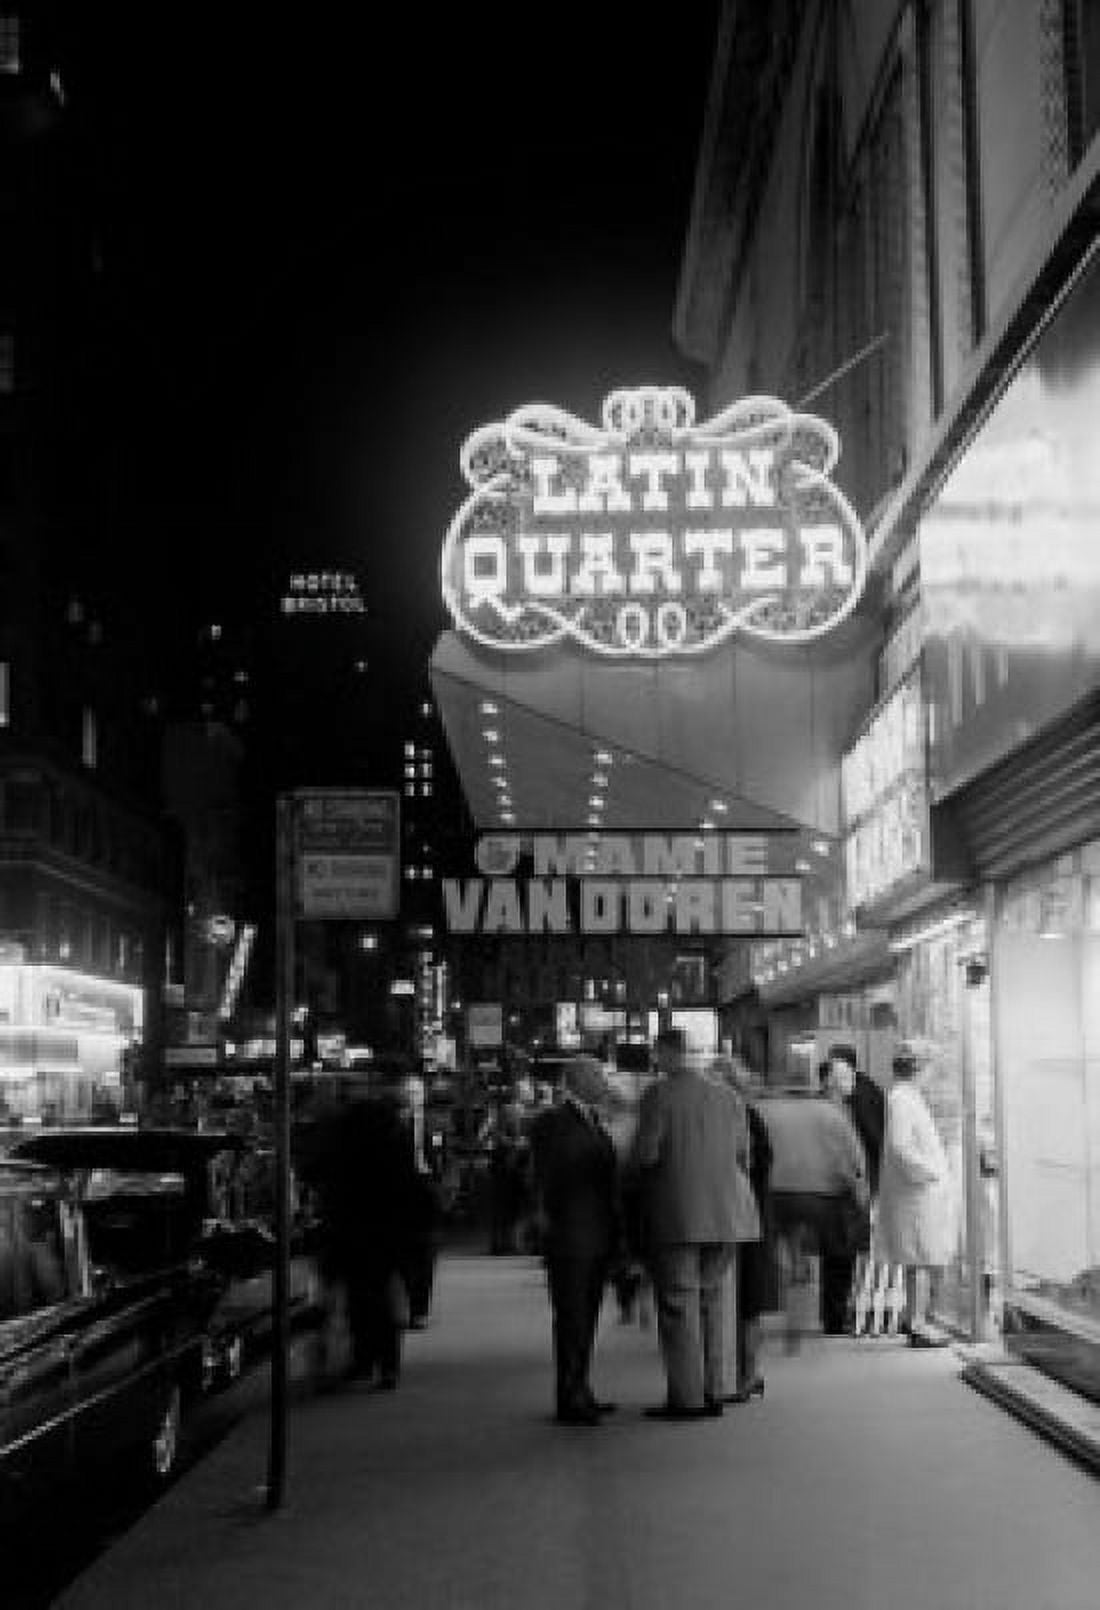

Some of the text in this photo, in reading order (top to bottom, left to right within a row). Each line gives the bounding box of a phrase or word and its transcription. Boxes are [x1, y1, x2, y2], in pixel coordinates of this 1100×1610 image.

[532, 449, 775, 514] LATIN
[464, 524, 852, 621] QUARTER
[534, 836, 768, 875] MAMIE
[442, 879, 801, 934] VAN DOREN
